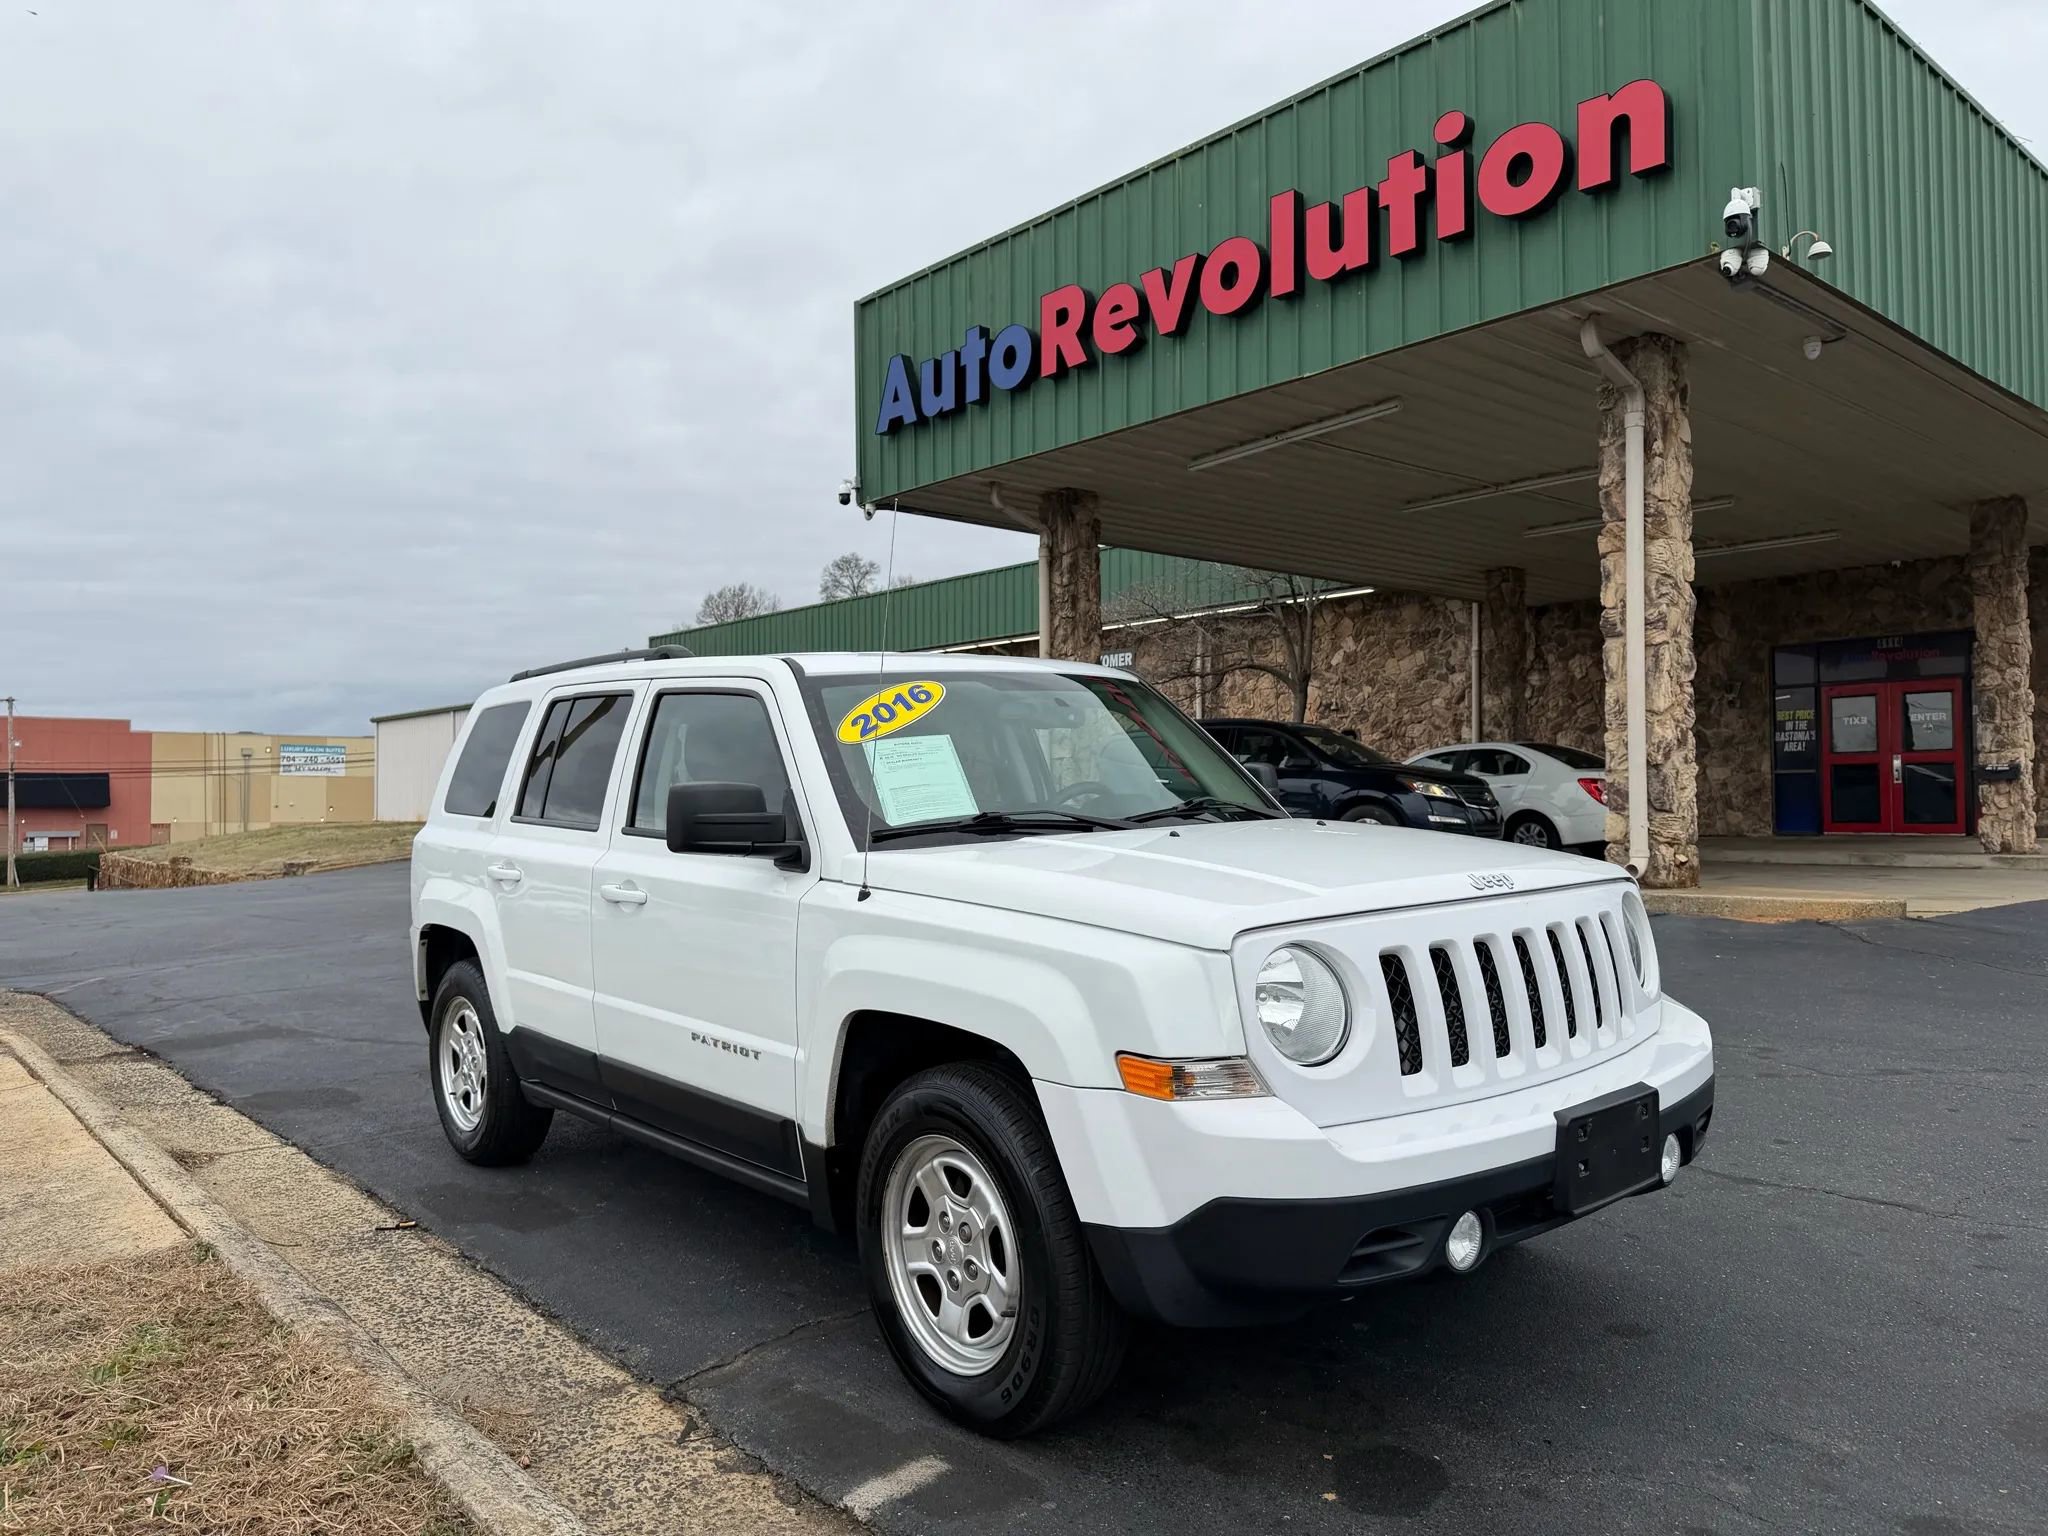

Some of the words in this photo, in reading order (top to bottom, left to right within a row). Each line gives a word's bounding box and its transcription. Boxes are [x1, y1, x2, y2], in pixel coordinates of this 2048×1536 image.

[1100, 652, 1132, 667] OMER
[851, 685, 934, 738] 2016
[1776, 711, 1793, 720] BEST
[1795, 709, 1815, 719] PRICE
[1910, 712, 1946, 721] ENTER
[1785, 721, 1793, 730] IN
[1795, 720, 1808, 730] THE
[1784, 741, 1806, 752] AREA!
[1465, 872, 1515, 891] Jeep
[690, 1031, 761, 1060] PATRIOT
